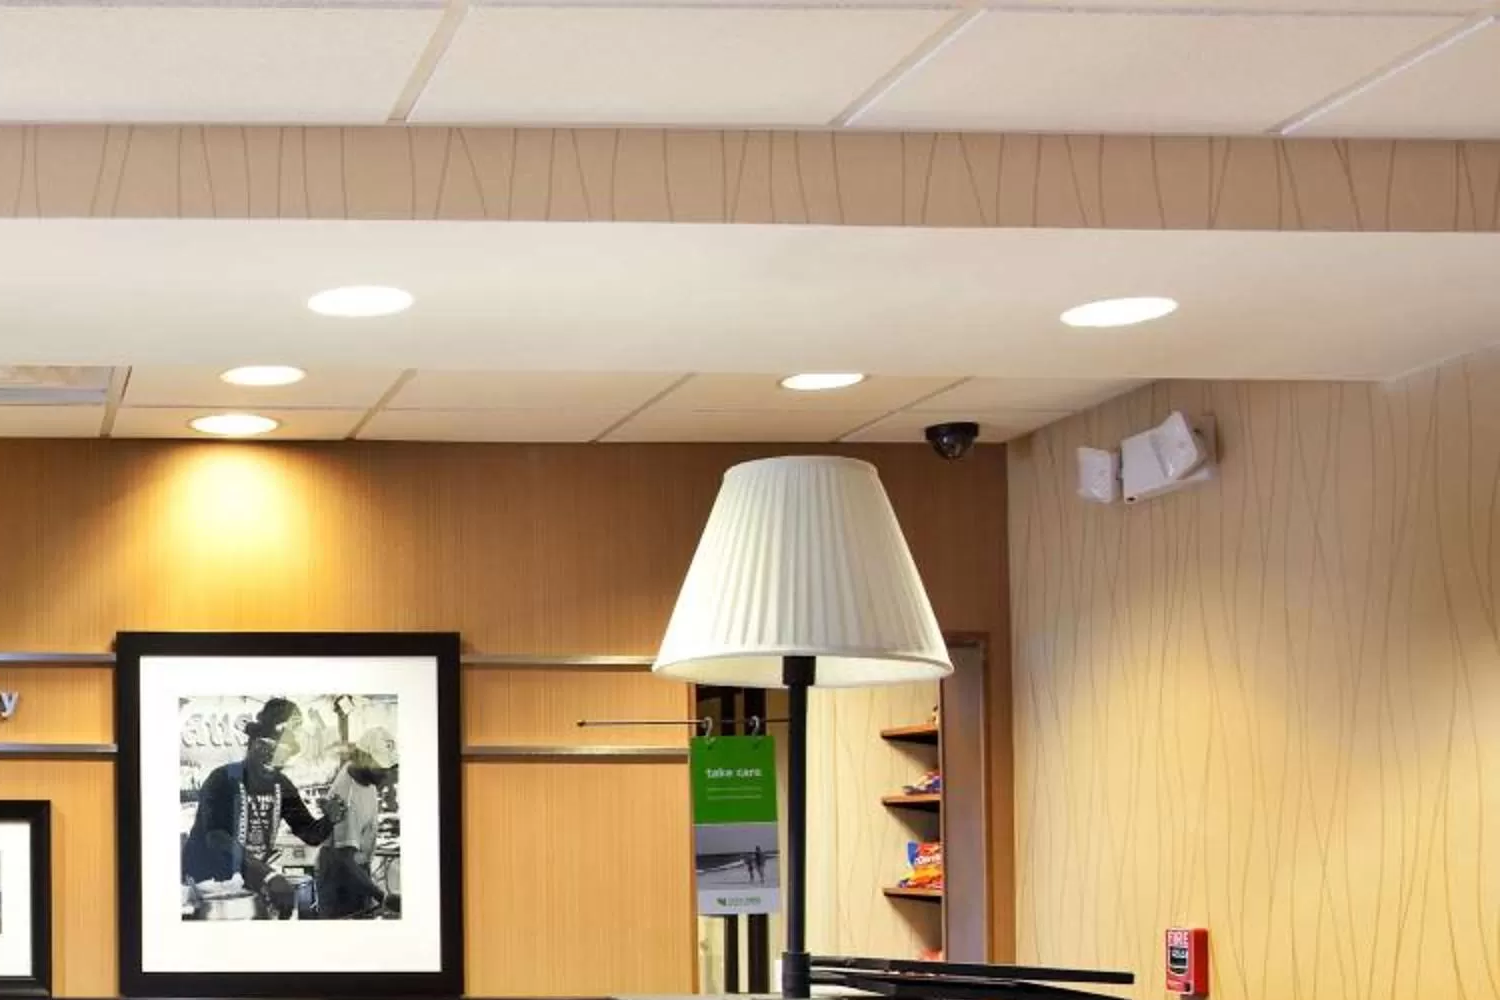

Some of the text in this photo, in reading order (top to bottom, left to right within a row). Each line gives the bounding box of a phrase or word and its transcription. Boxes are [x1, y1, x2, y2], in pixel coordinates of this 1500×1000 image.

[706, 767, 762, 778] take care
[1168, 931, 1189, 947] FIRE
